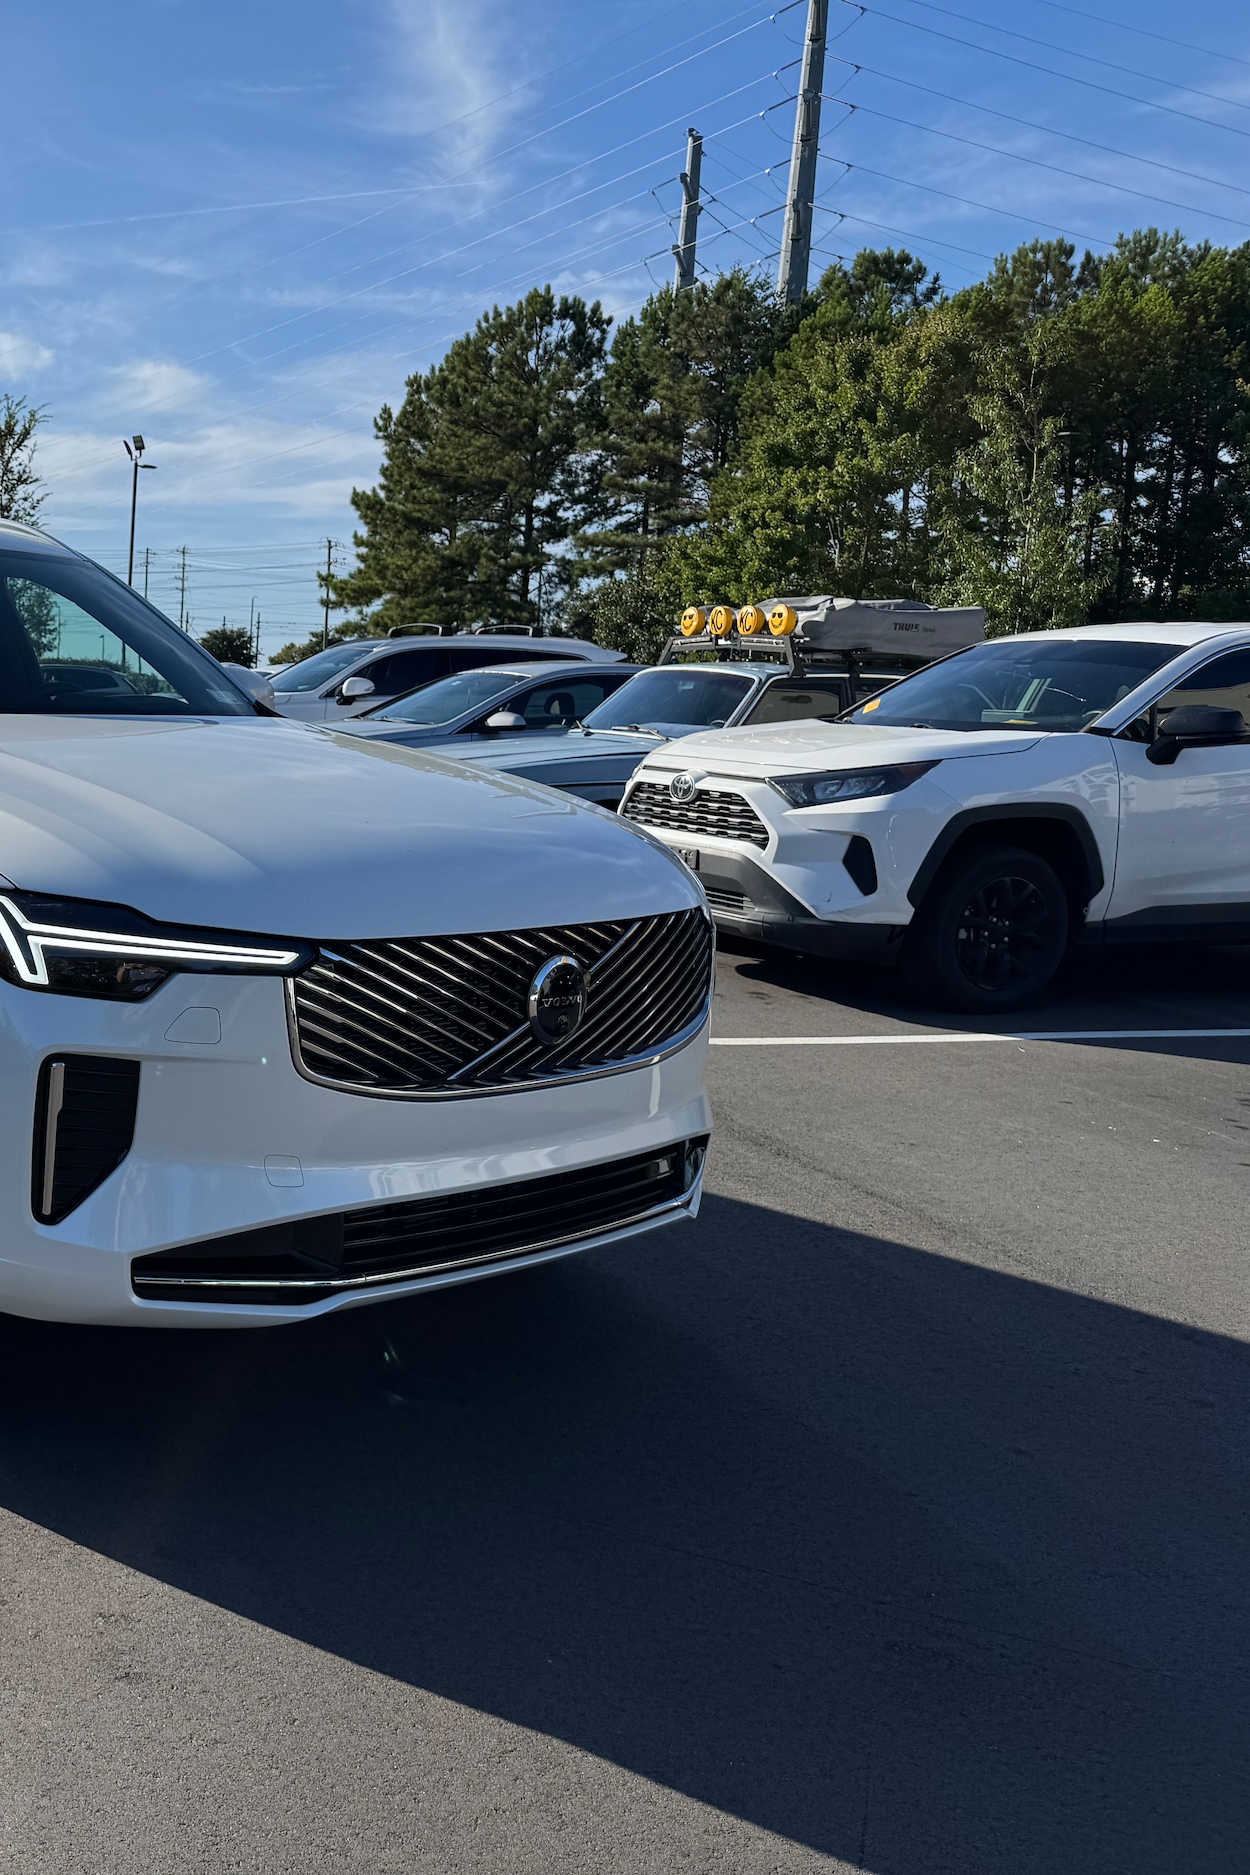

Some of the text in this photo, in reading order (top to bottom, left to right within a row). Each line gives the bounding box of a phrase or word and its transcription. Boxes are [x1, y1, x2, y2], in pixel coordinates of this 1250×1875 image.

[711, 609, 723, 633] KC
[739, 609, 754, 632] KC
[893, 622, 920, 632] THULE
[541, 995, 583, 1008] VOLVO
